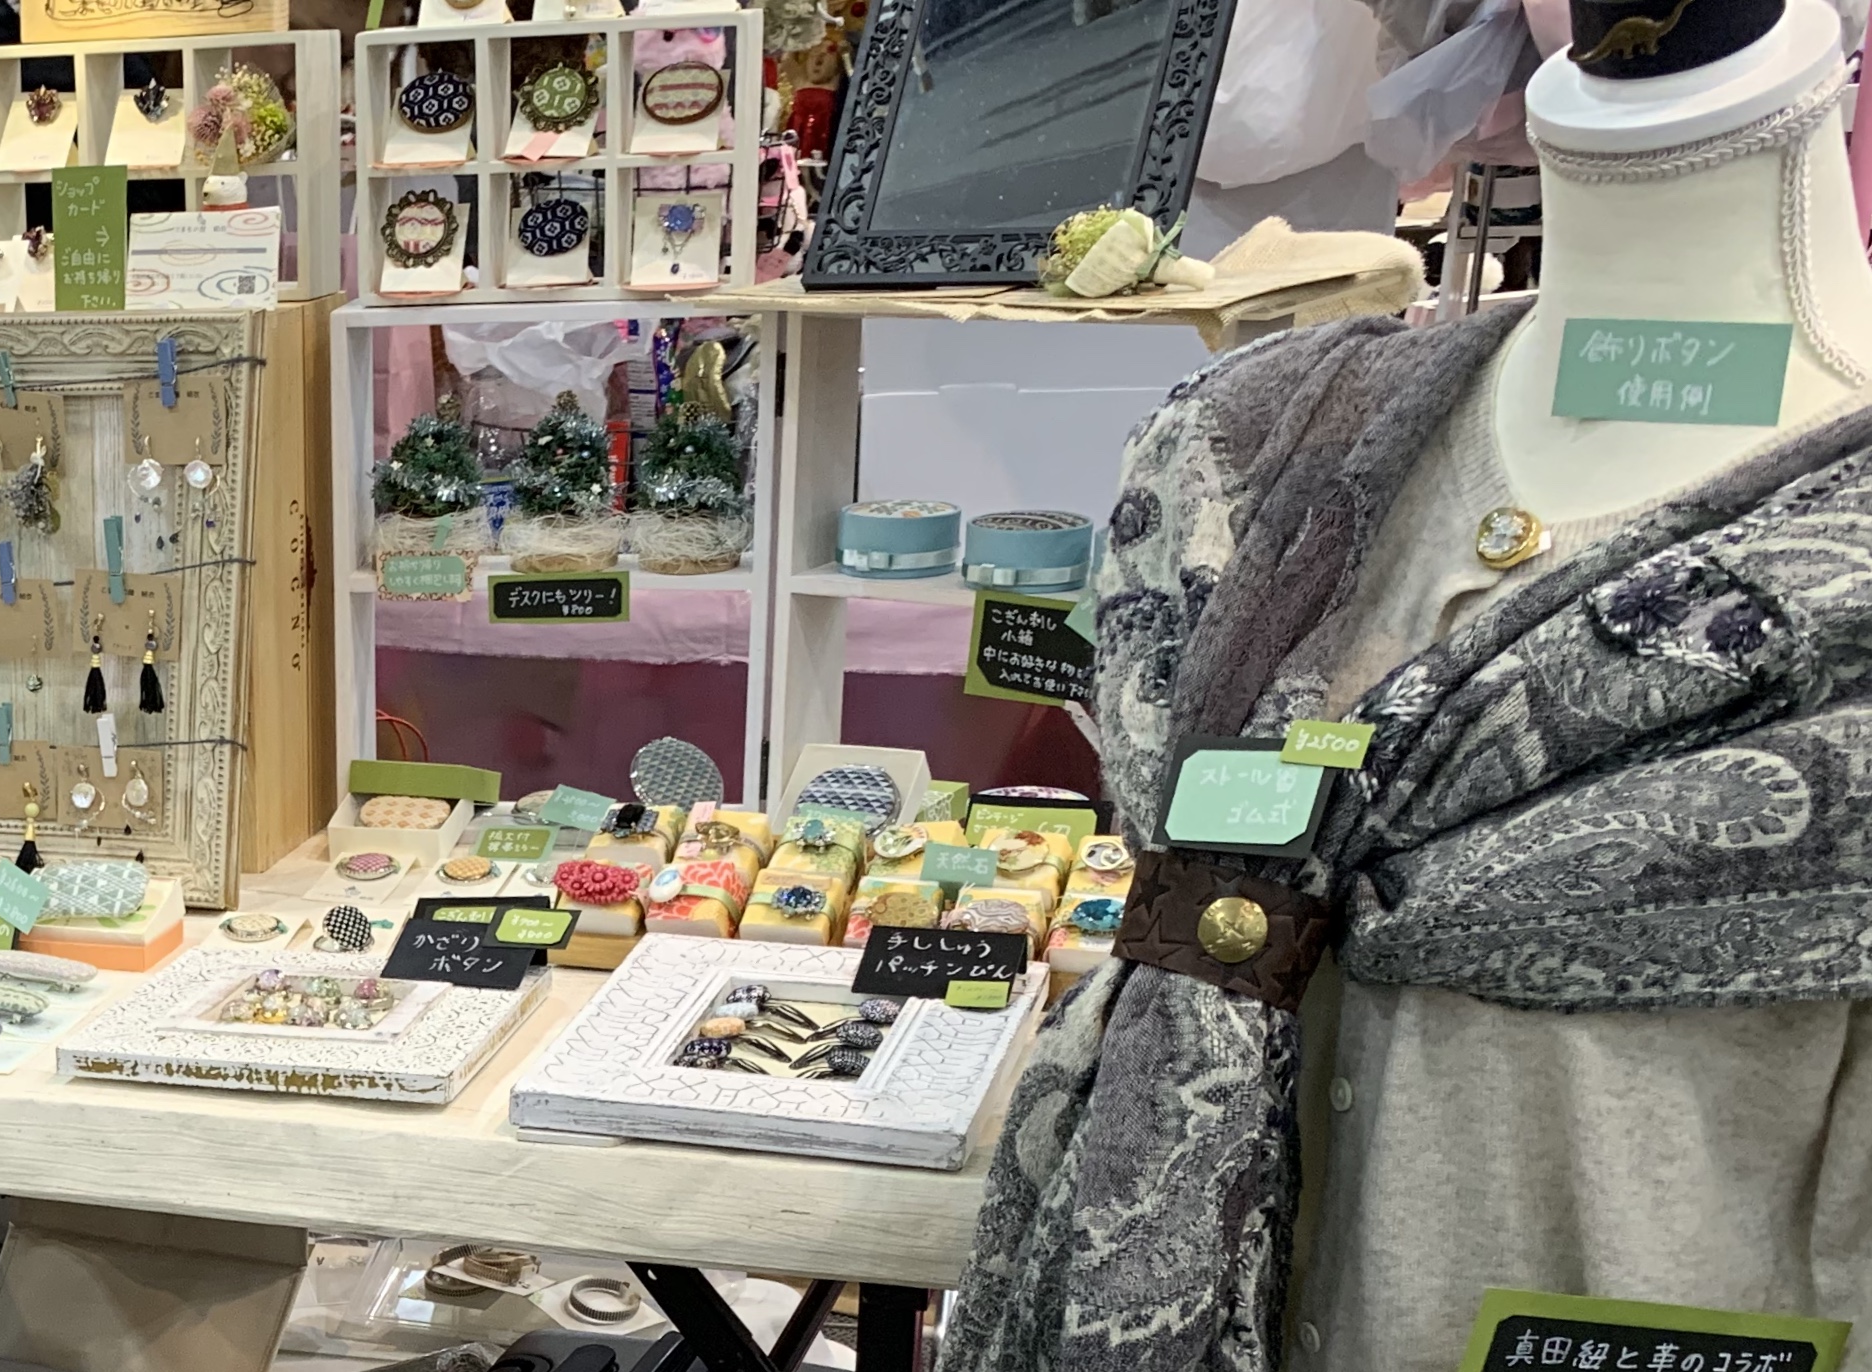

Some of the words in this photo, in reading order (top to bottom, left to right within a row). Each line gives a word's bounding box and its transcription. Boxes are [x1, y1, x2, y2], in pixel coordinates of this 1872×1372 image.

[68, 199, 105, 216] カード
[61, 247, 110, 266] ご自由に
[63, 268, 120, 285] お持ち帰り
[1579, 329, 1735, 367] 飾りボタン
[991, 608, 1057, 631] こぎん刺し
[1001, 629, 1034, 646] 小箱
[1227, 800, 1297, 824] ゴム式
[936, 852, 988, 874] 天然石
[413, 933, 479, 952] かざり
[887, 932, 991, 958] 手ししゅう
[429, 953, 503, 972] ボタン
[875, 955, 1013, 979] パッチンぴん
